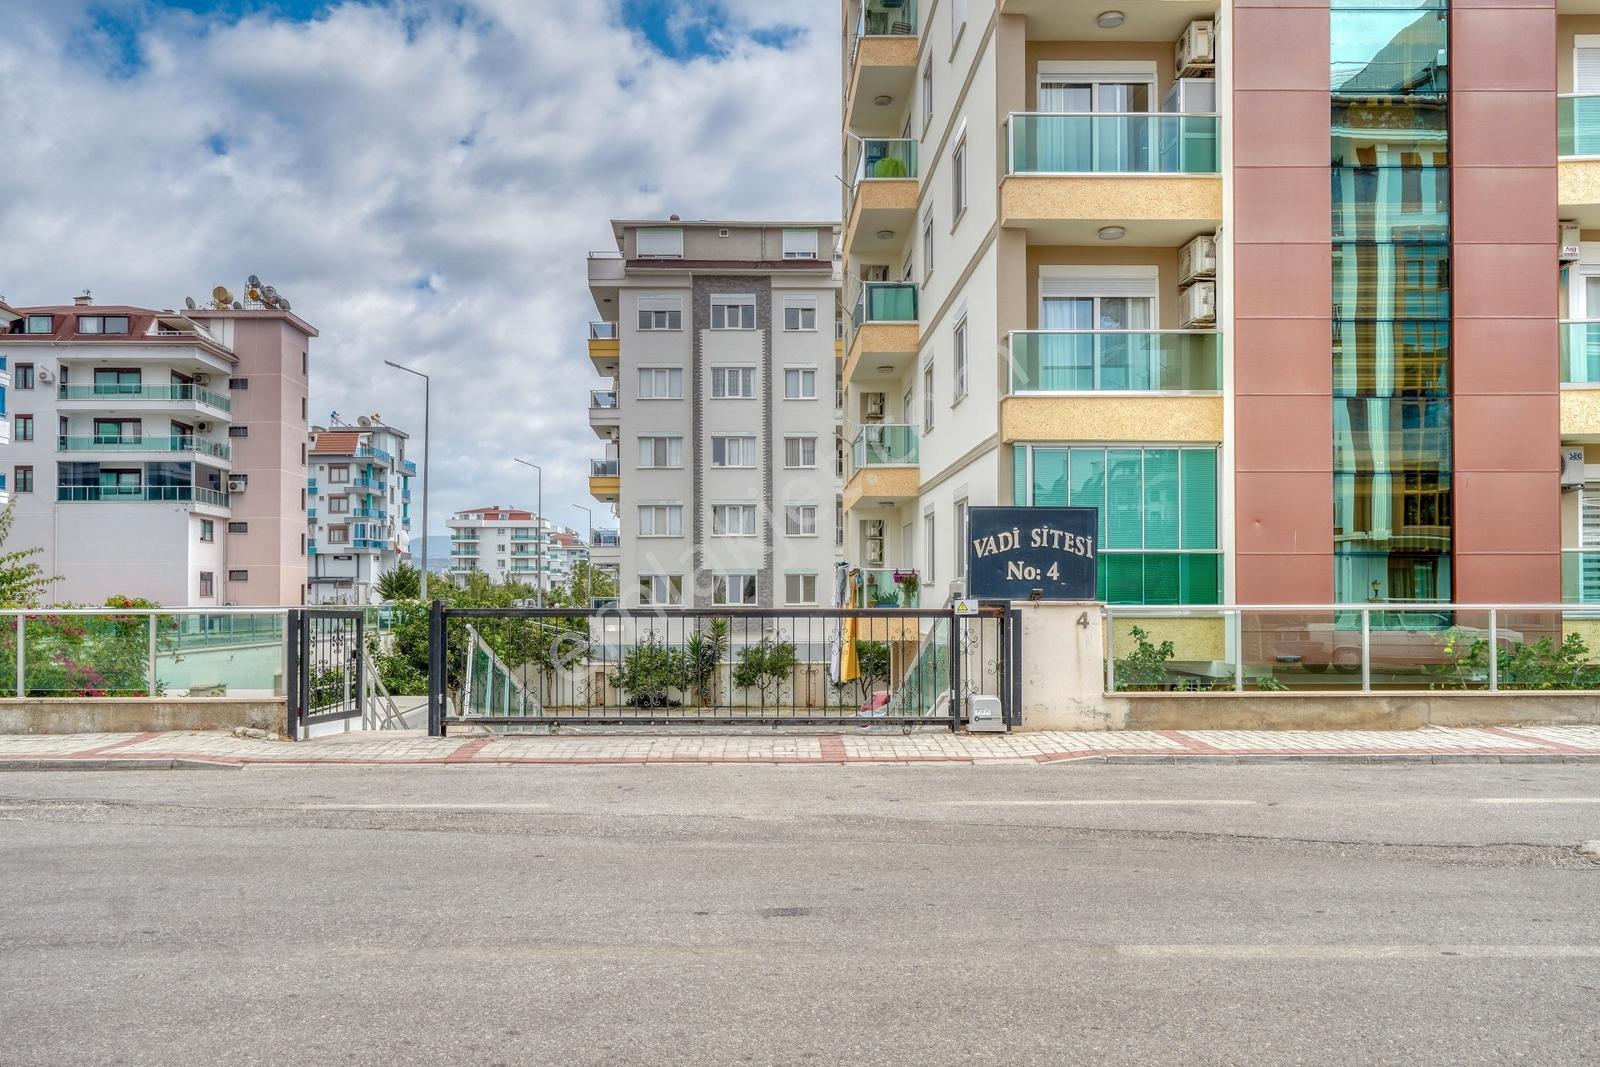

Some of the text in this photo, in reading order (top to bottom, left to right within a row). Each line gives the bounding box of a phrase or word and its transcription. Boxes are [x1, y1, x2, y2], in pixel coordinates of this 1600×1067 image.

[973, 525, 1093, 559] VADİ SİTESİ
[1006, 561, 1060, 580] No: 4
[1077, 611, 1090, 629] 4
